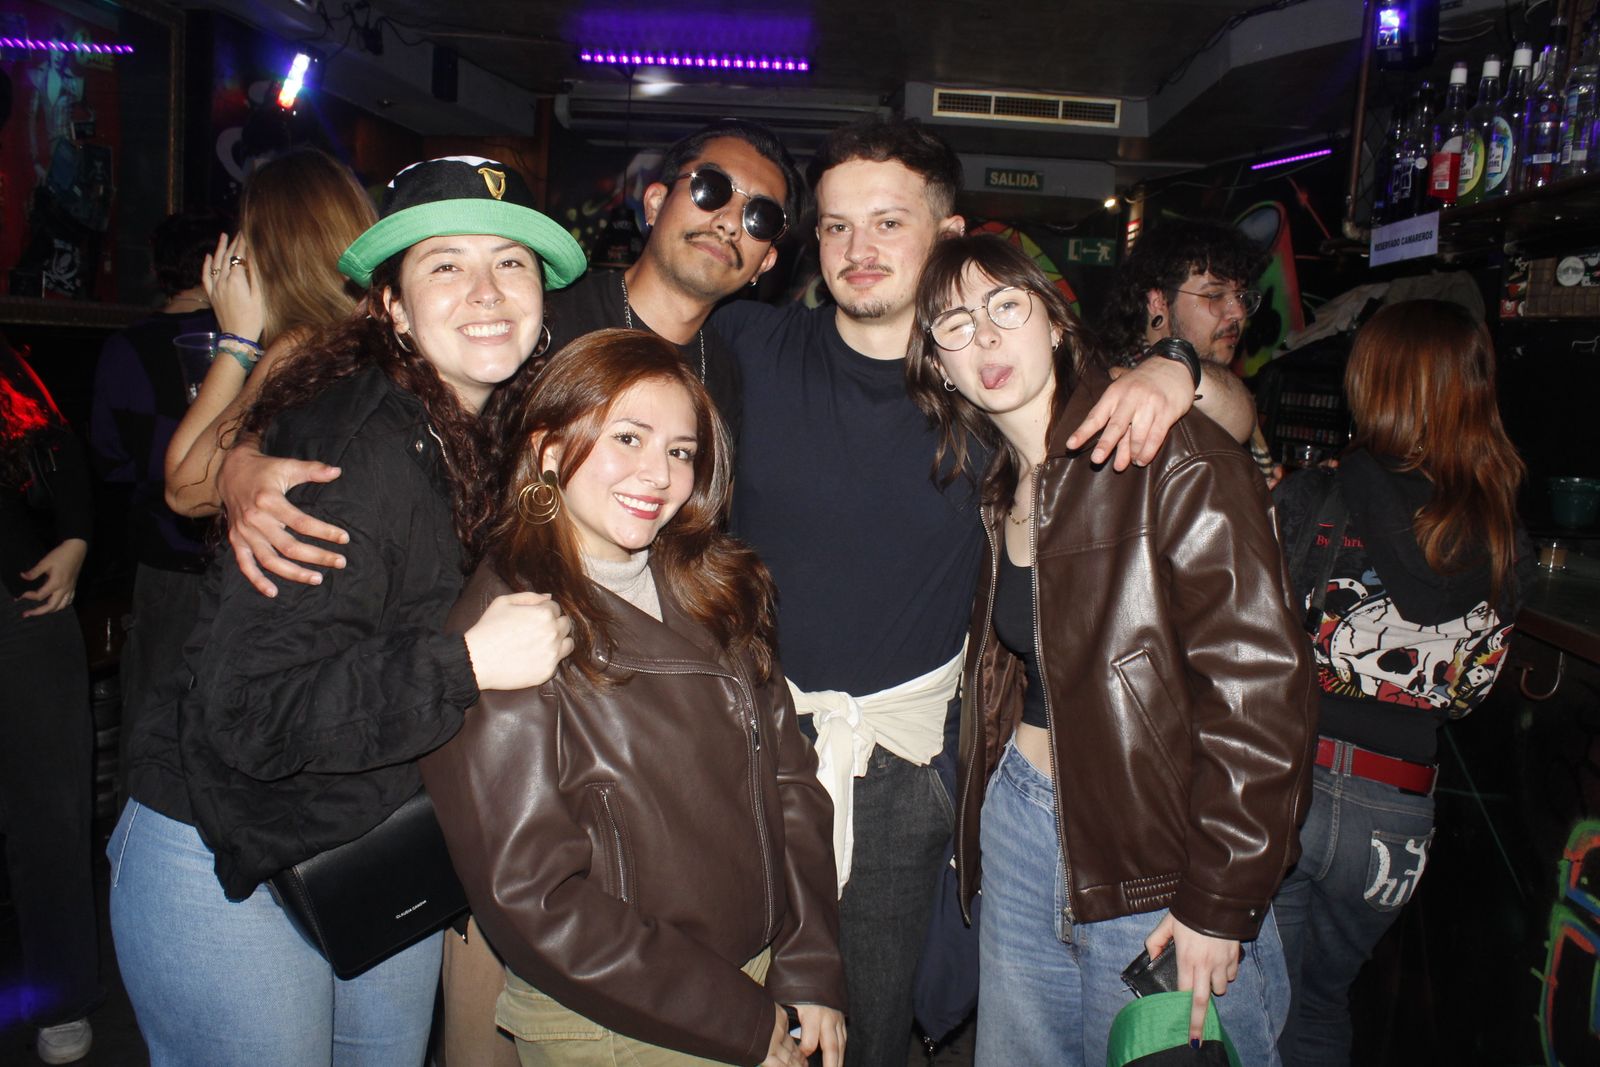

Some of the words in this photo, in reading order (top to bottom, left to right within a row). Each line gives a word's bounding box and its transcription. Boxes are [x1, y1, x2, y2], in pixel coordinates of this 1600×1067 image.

[990, 171, 1038, 188] SALIDA
[1374, 237, 1400, 252] RESERVADO
[1401, 230, 1433, 246] CAMAREROS
